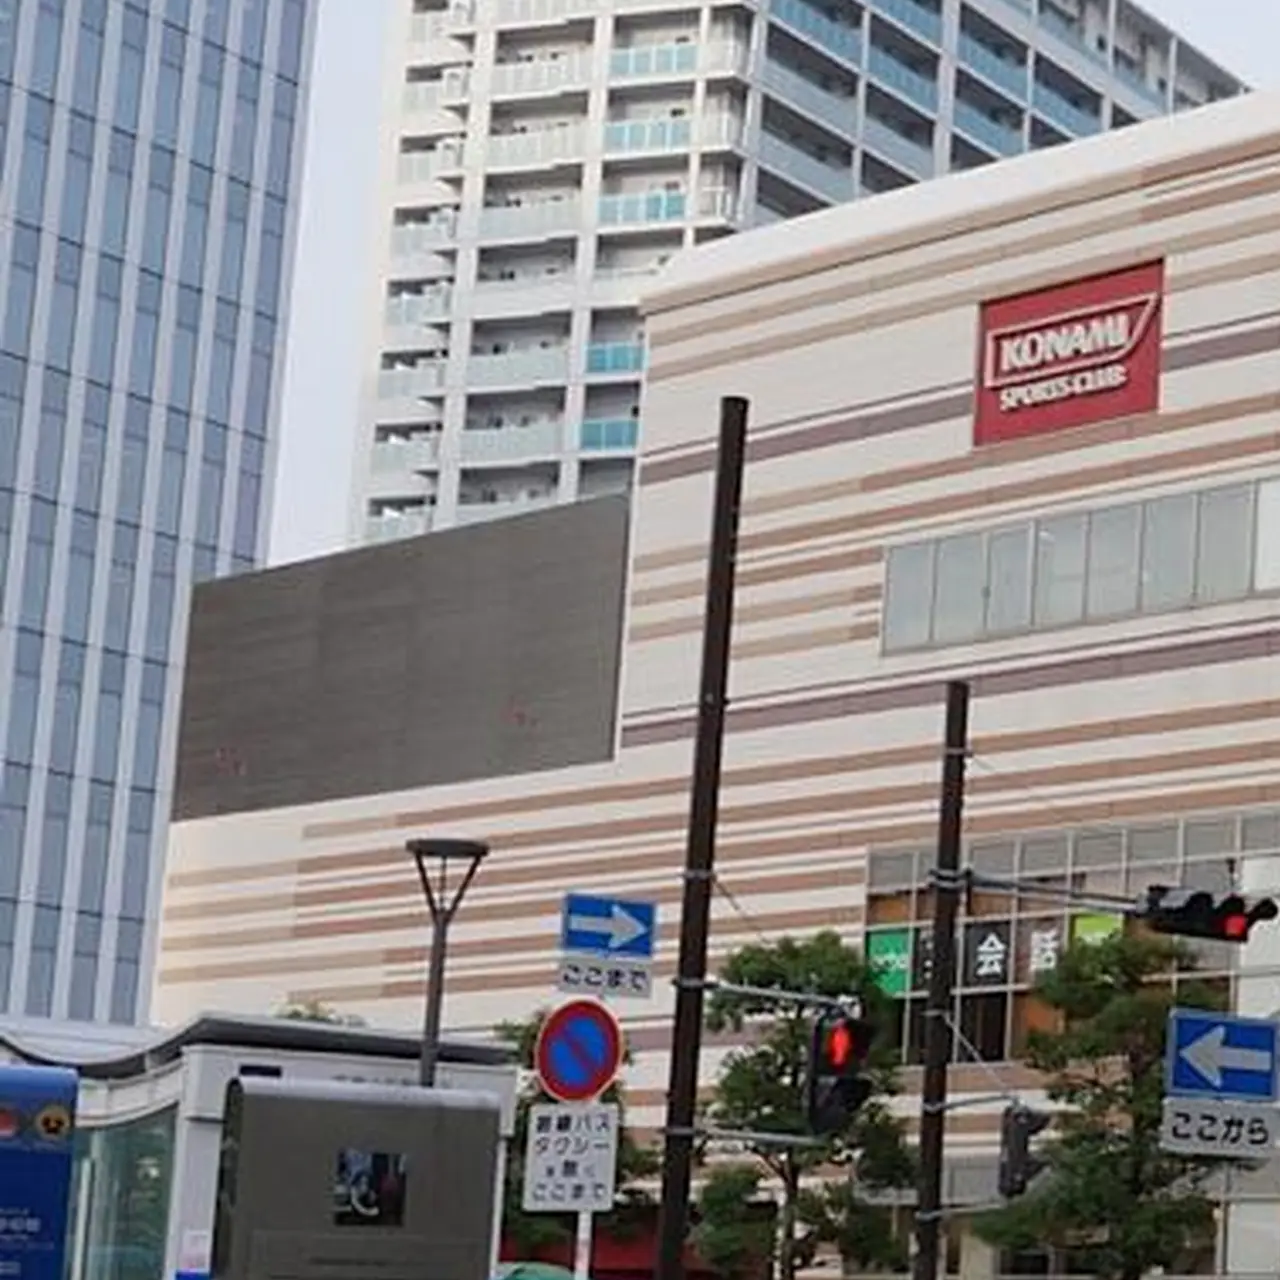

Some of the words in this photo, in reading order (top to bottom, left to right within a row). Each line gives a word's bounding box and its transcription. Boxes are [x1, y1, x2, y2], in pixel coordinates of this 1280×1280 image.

[1000, 313, 1129, 371] KONAMI
[562, 964, 648, 990] ここまで
[1172, 1111, 1270, 1145] ここから
